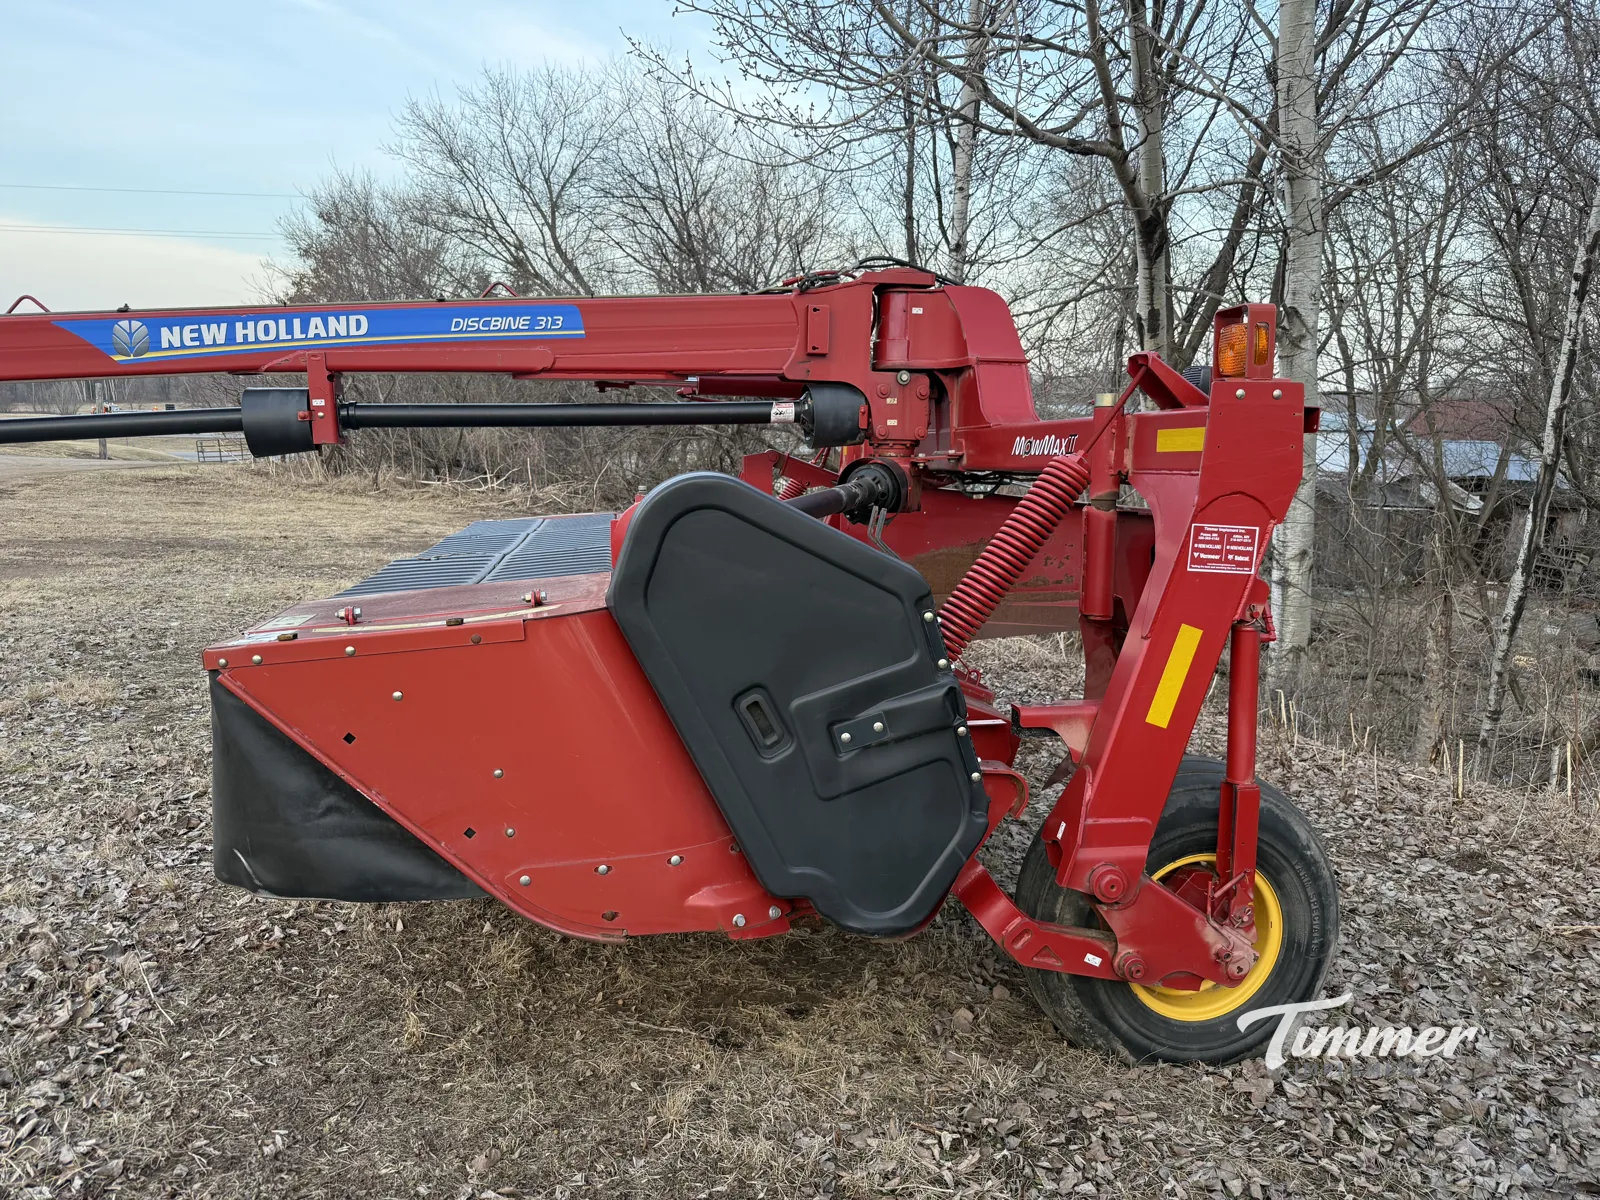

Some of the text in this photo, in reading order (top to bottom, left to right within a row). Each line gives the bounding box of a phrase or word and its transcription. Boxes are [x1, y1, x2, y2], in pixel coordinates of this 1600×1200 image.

[160, 314, 370, 349] NEW HOLLAND
[451, 316, 564, 332] DISCBINE 313
